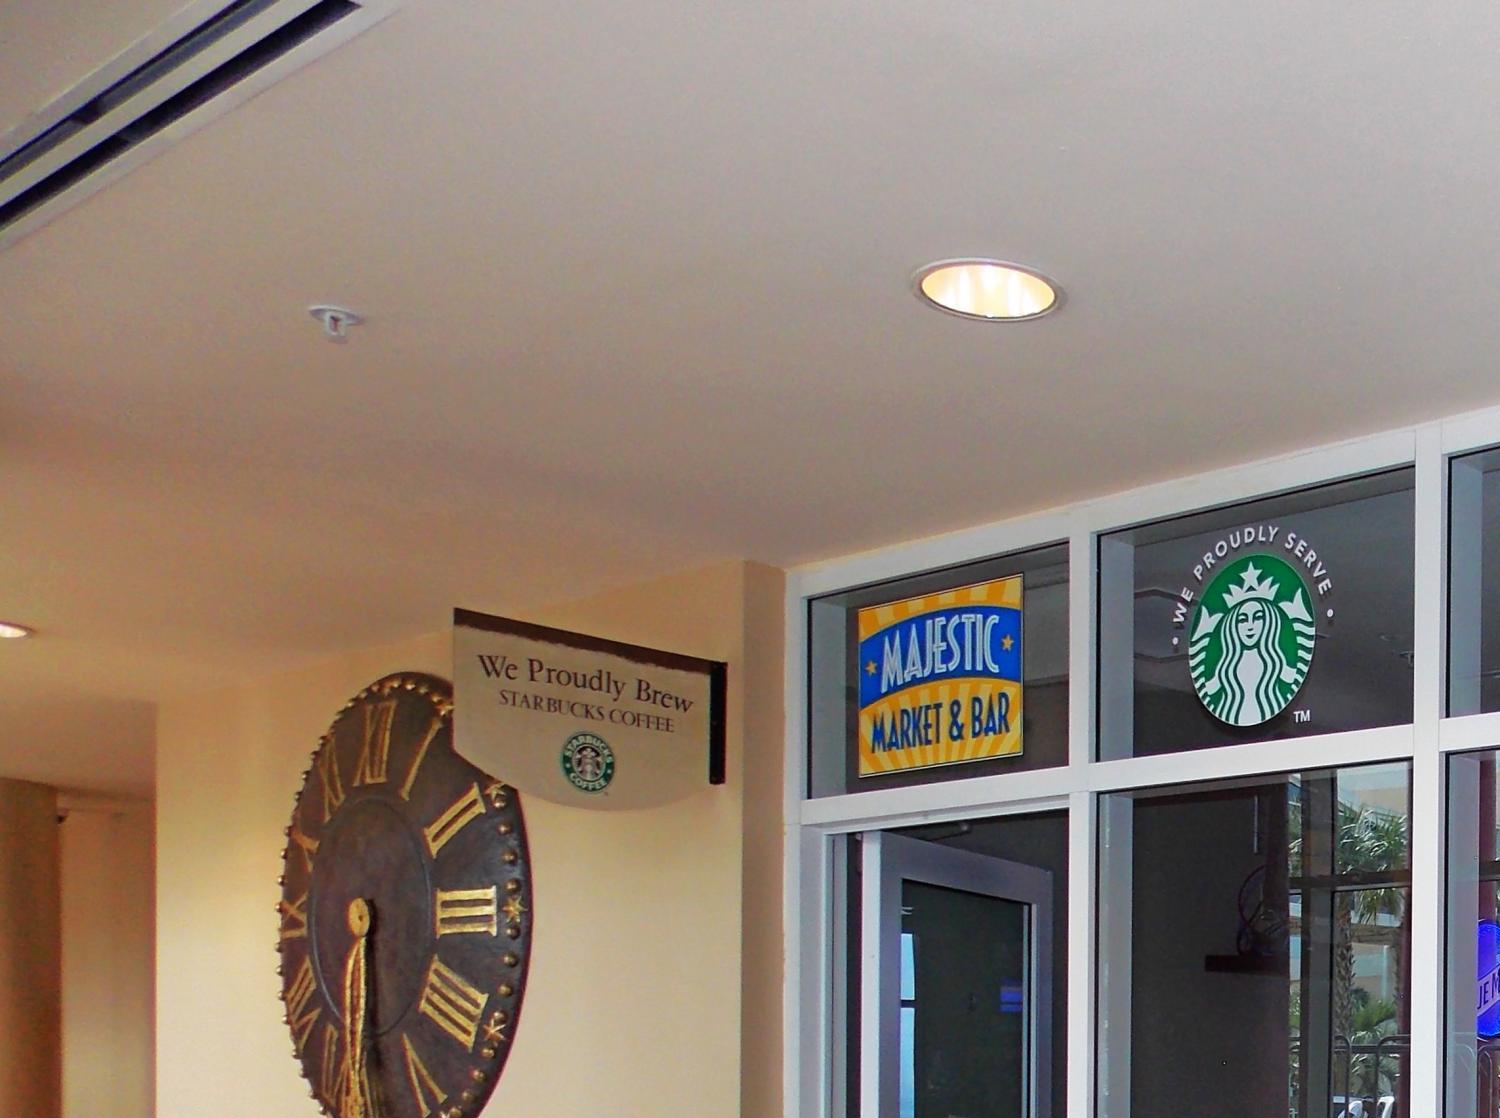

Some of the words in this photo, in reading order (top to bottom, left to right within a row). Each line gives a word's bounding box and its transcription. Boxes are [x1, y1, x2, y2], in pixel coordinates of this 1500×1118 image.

[1173, 587, 1195, 624] WE
[1193, 525, 1280, 581] PROUDLY
[1284, 532, 1333, 595] SERVE
[880, 613, 1000, 694] MAJESTIC
[477, 654, 519, 681] We
[527, 658, 627, 702] Proudly
[635, 678, 694, 714] Brew
[499, 689, 606, 722] STARBUCKS
[609, 708, 675, 733] COFFEE
[564, 734, 613, 764] STARBUCKS
[871, 702, 943, 754] MARKET
[949, 699, 965, 742] &
[971, 692, 1011, 739] BAR
[569, 772, 608, 791] COFFEE
